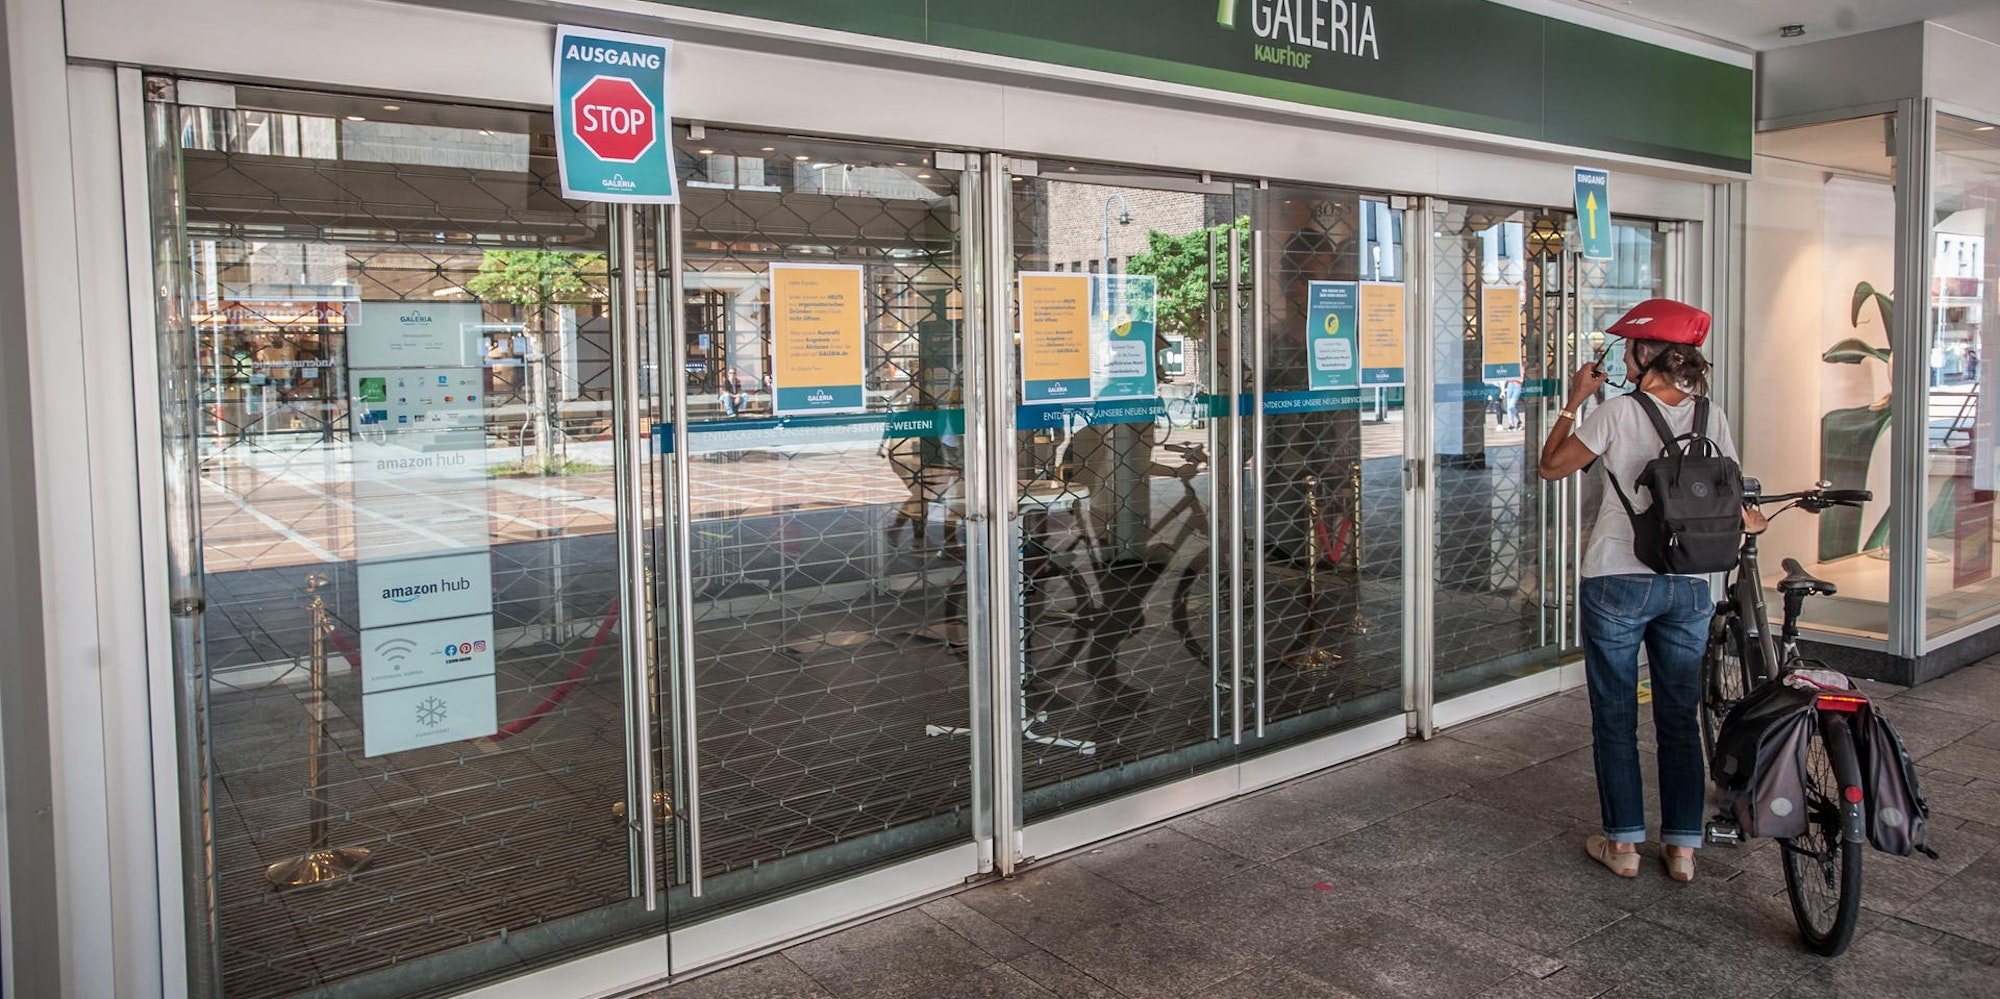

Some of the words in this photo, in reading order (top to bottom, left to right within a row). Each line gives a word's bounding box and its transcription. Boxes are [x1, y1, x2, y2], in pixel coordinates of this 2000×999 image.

[1252, 0, 1379, 60] GALERIA
[566, 45, 661, 70] AUSGANG
[582, 104, 645, 136] STOP
[602, 179, 636, 188] GALERIA
[1577, 174, 1605, 186] EINGANG
[1124, 407, 1148, 416] NEUEN
[852, 420, 933, 434] SERVICE-WELTEN!
[376, 457, 432, 470] amazon
[436, 452, 465, 467] hub
[382, 583, 438, 599] amazon
[441, 577, 470, 592] hub
